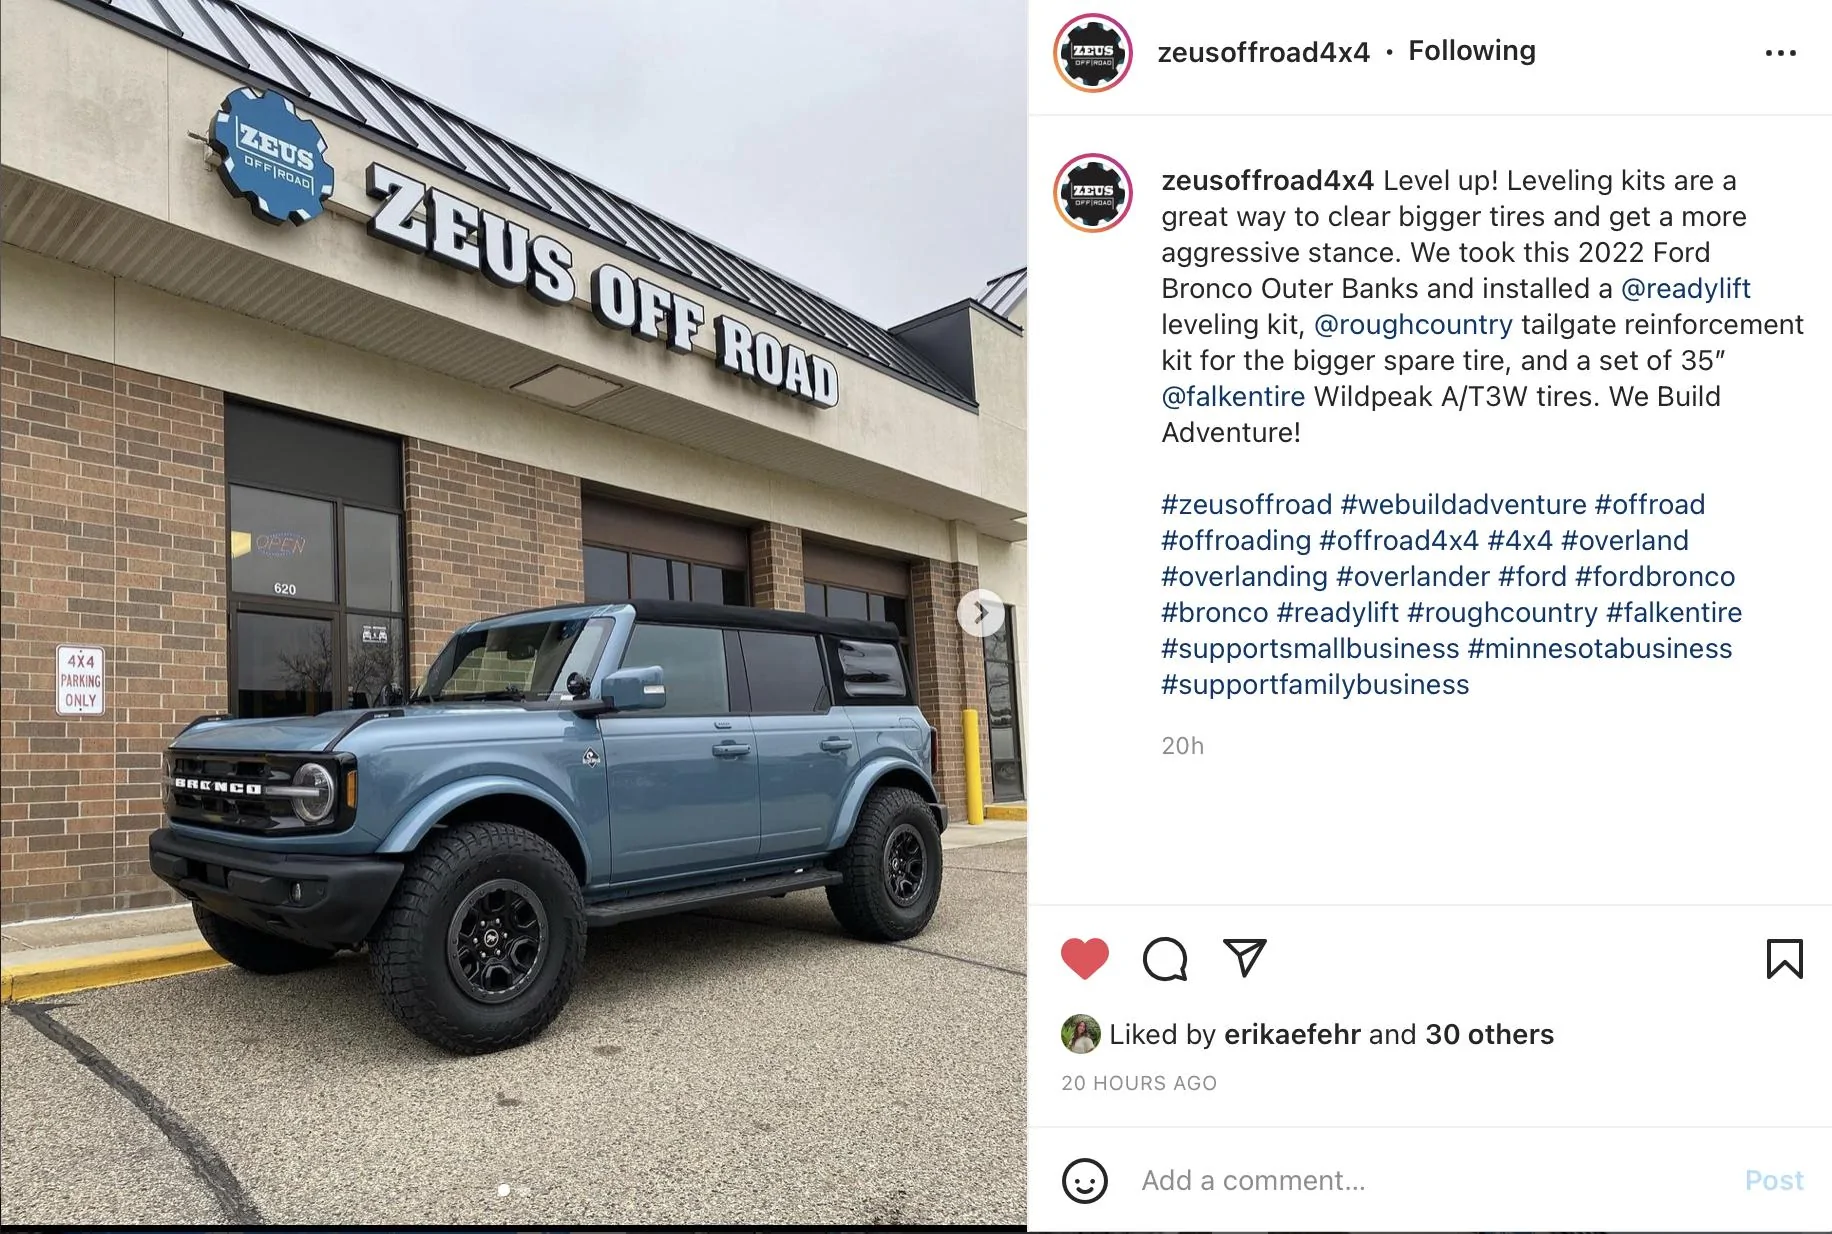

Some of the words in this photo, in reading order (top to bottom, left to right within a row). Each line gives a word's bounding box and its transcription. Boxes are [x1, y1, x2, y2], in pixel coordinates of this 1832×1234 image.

[240, 123, 314, 171] ZEUS
[277, 168, 310, 189] ROAD
[367, 161, 576, 305] ZEUS
[592, 263, 705, 354] OFF
[715, 314, 839, 409] ROAD
[256, 535, 306, 553] OPEN
[274, 582, 297, 596] 620
[67, 654, 95, 669] 4X4
[61, 673, 101, 688] PARKING
[65, 693, 97, 708] ONLY
